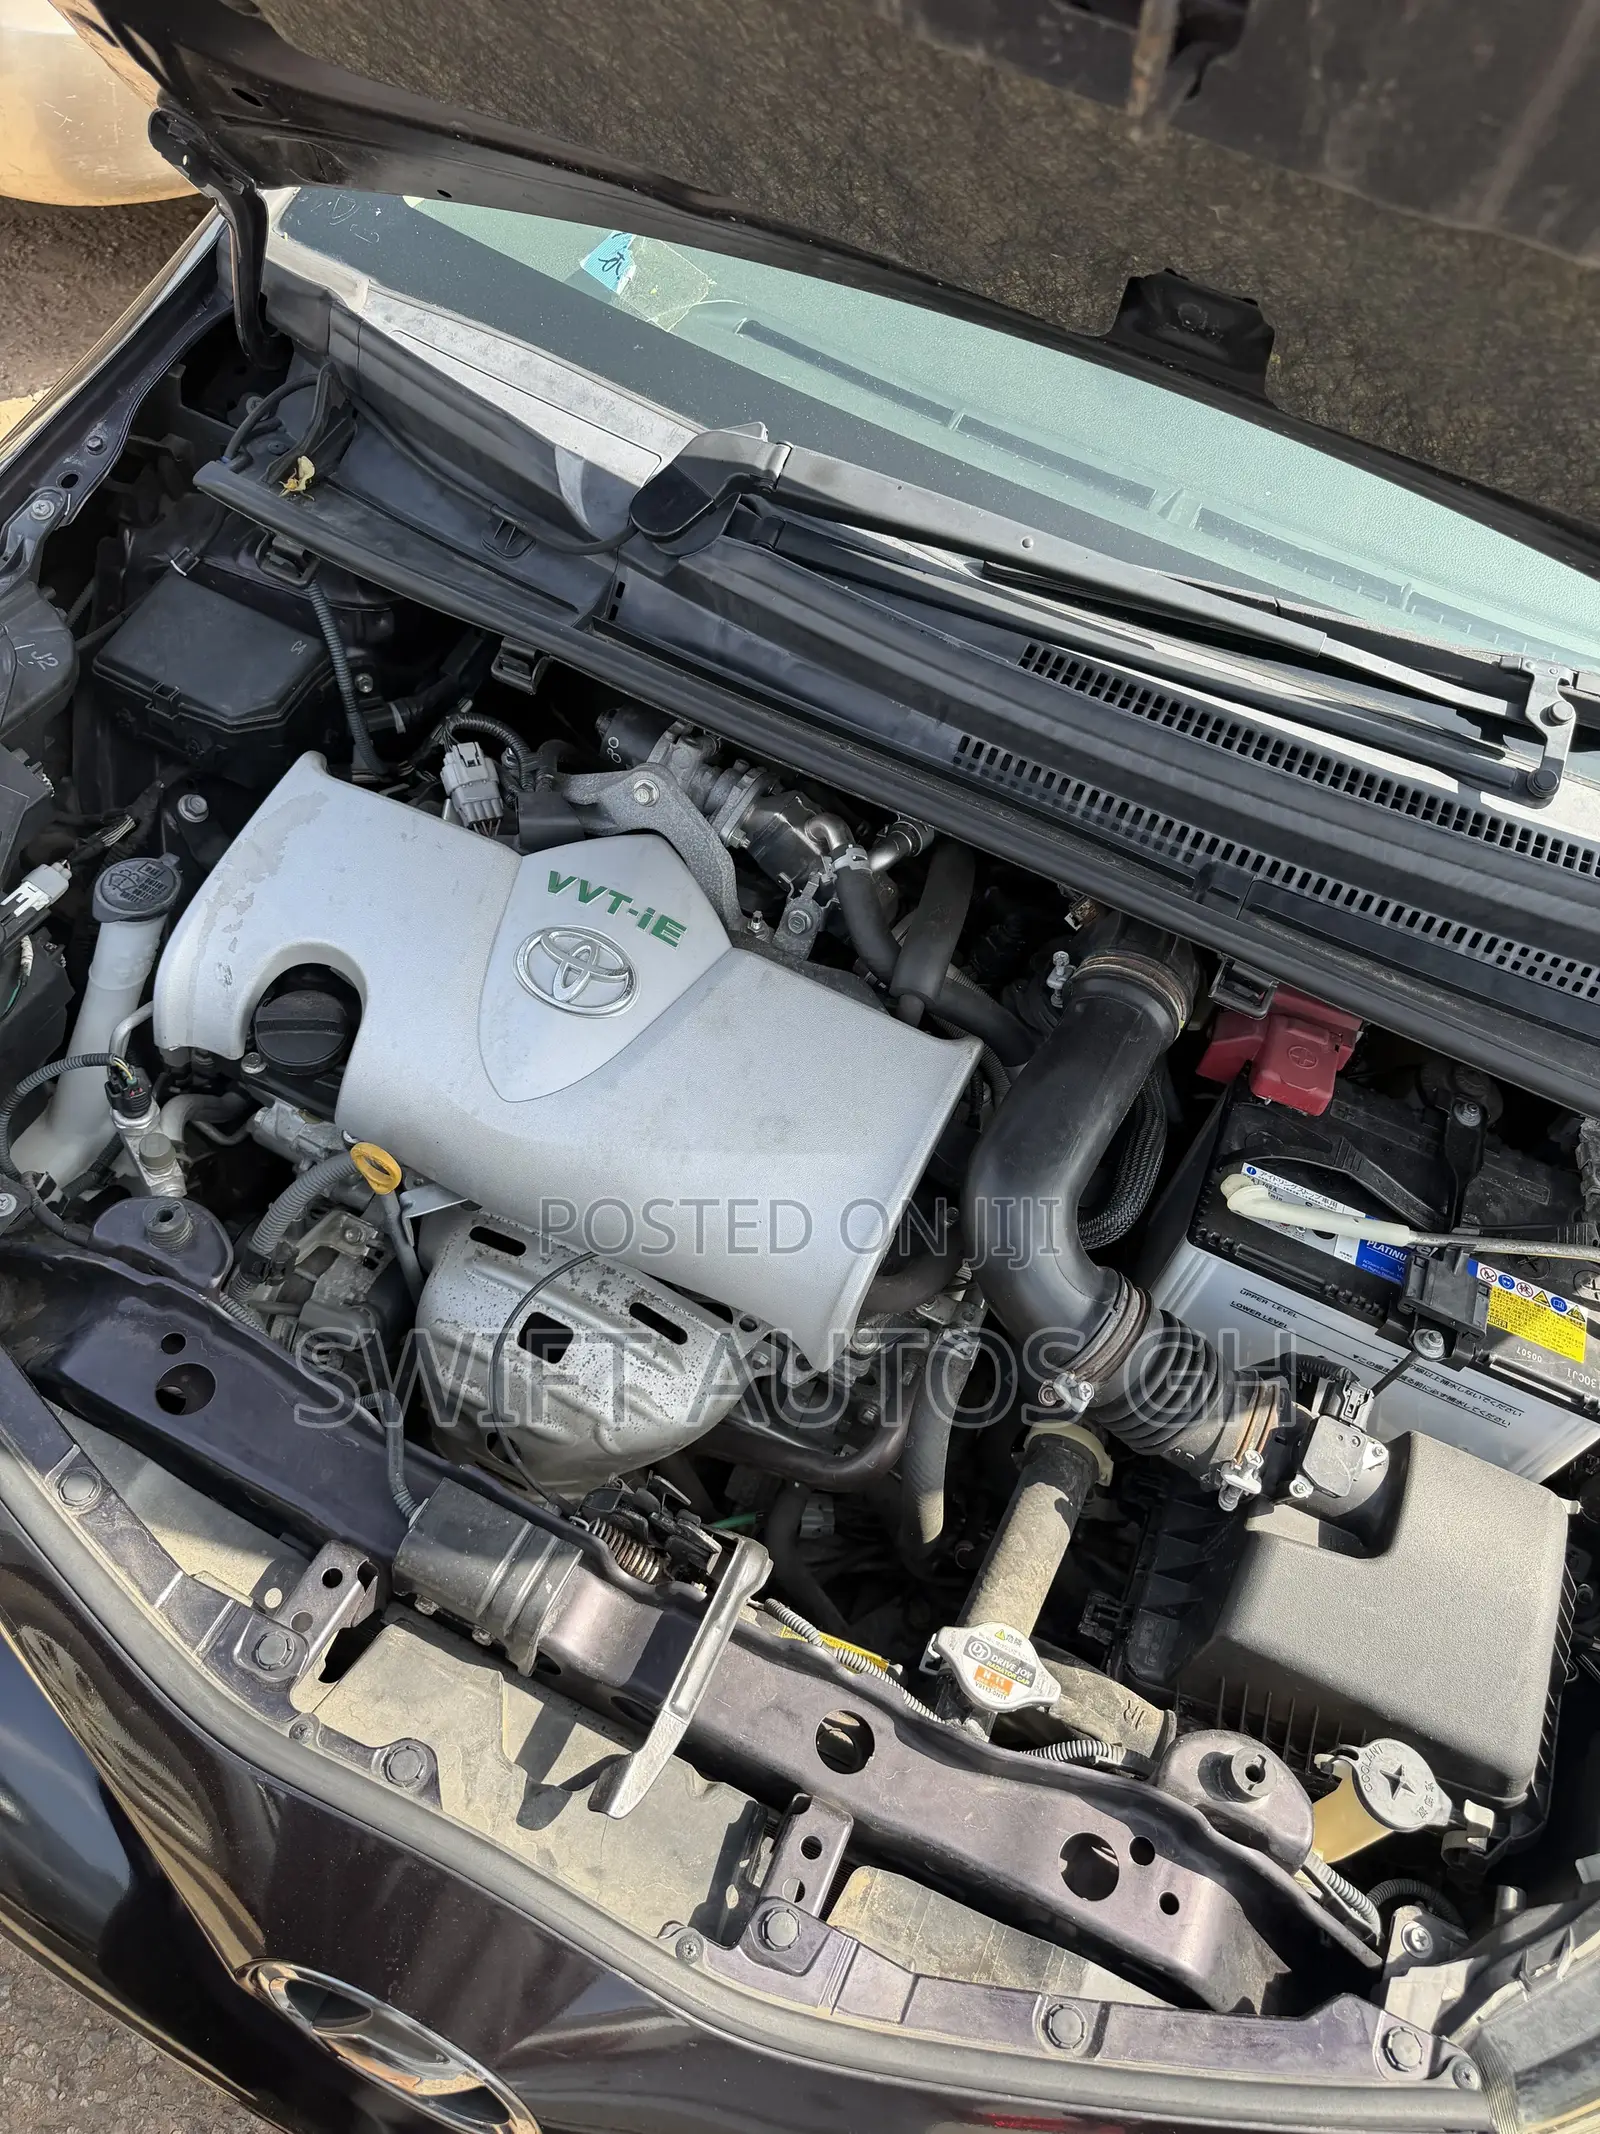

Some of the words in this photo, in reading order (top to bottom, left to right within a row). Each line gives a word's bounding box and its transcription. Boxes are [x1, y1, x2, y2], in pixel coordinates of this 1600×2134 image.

[547, 870, 689, 950] VVT-iE
[1366, 1240, 1408, 1261] PLATINU
[1231, 1300, 1262, 1317] LOWER
[1262, 1314, 1289, 1329] LEVEL
[1240, 1289, 1269, 1305] UPPER
[1271, 1303, 1298, 1319] LEVEL
[1487, 1315, 1508, 1329] ANGER
[986, 1661, 1018, 1680] RADIATOR
[1016, 1674, 1031, 1685] CAP
[990, 1653, 1017, 1673] DRIVE
[1014, 1665, 1034, 1680] JOY
[1360, 1742, 1384, 1793] COOLANT
